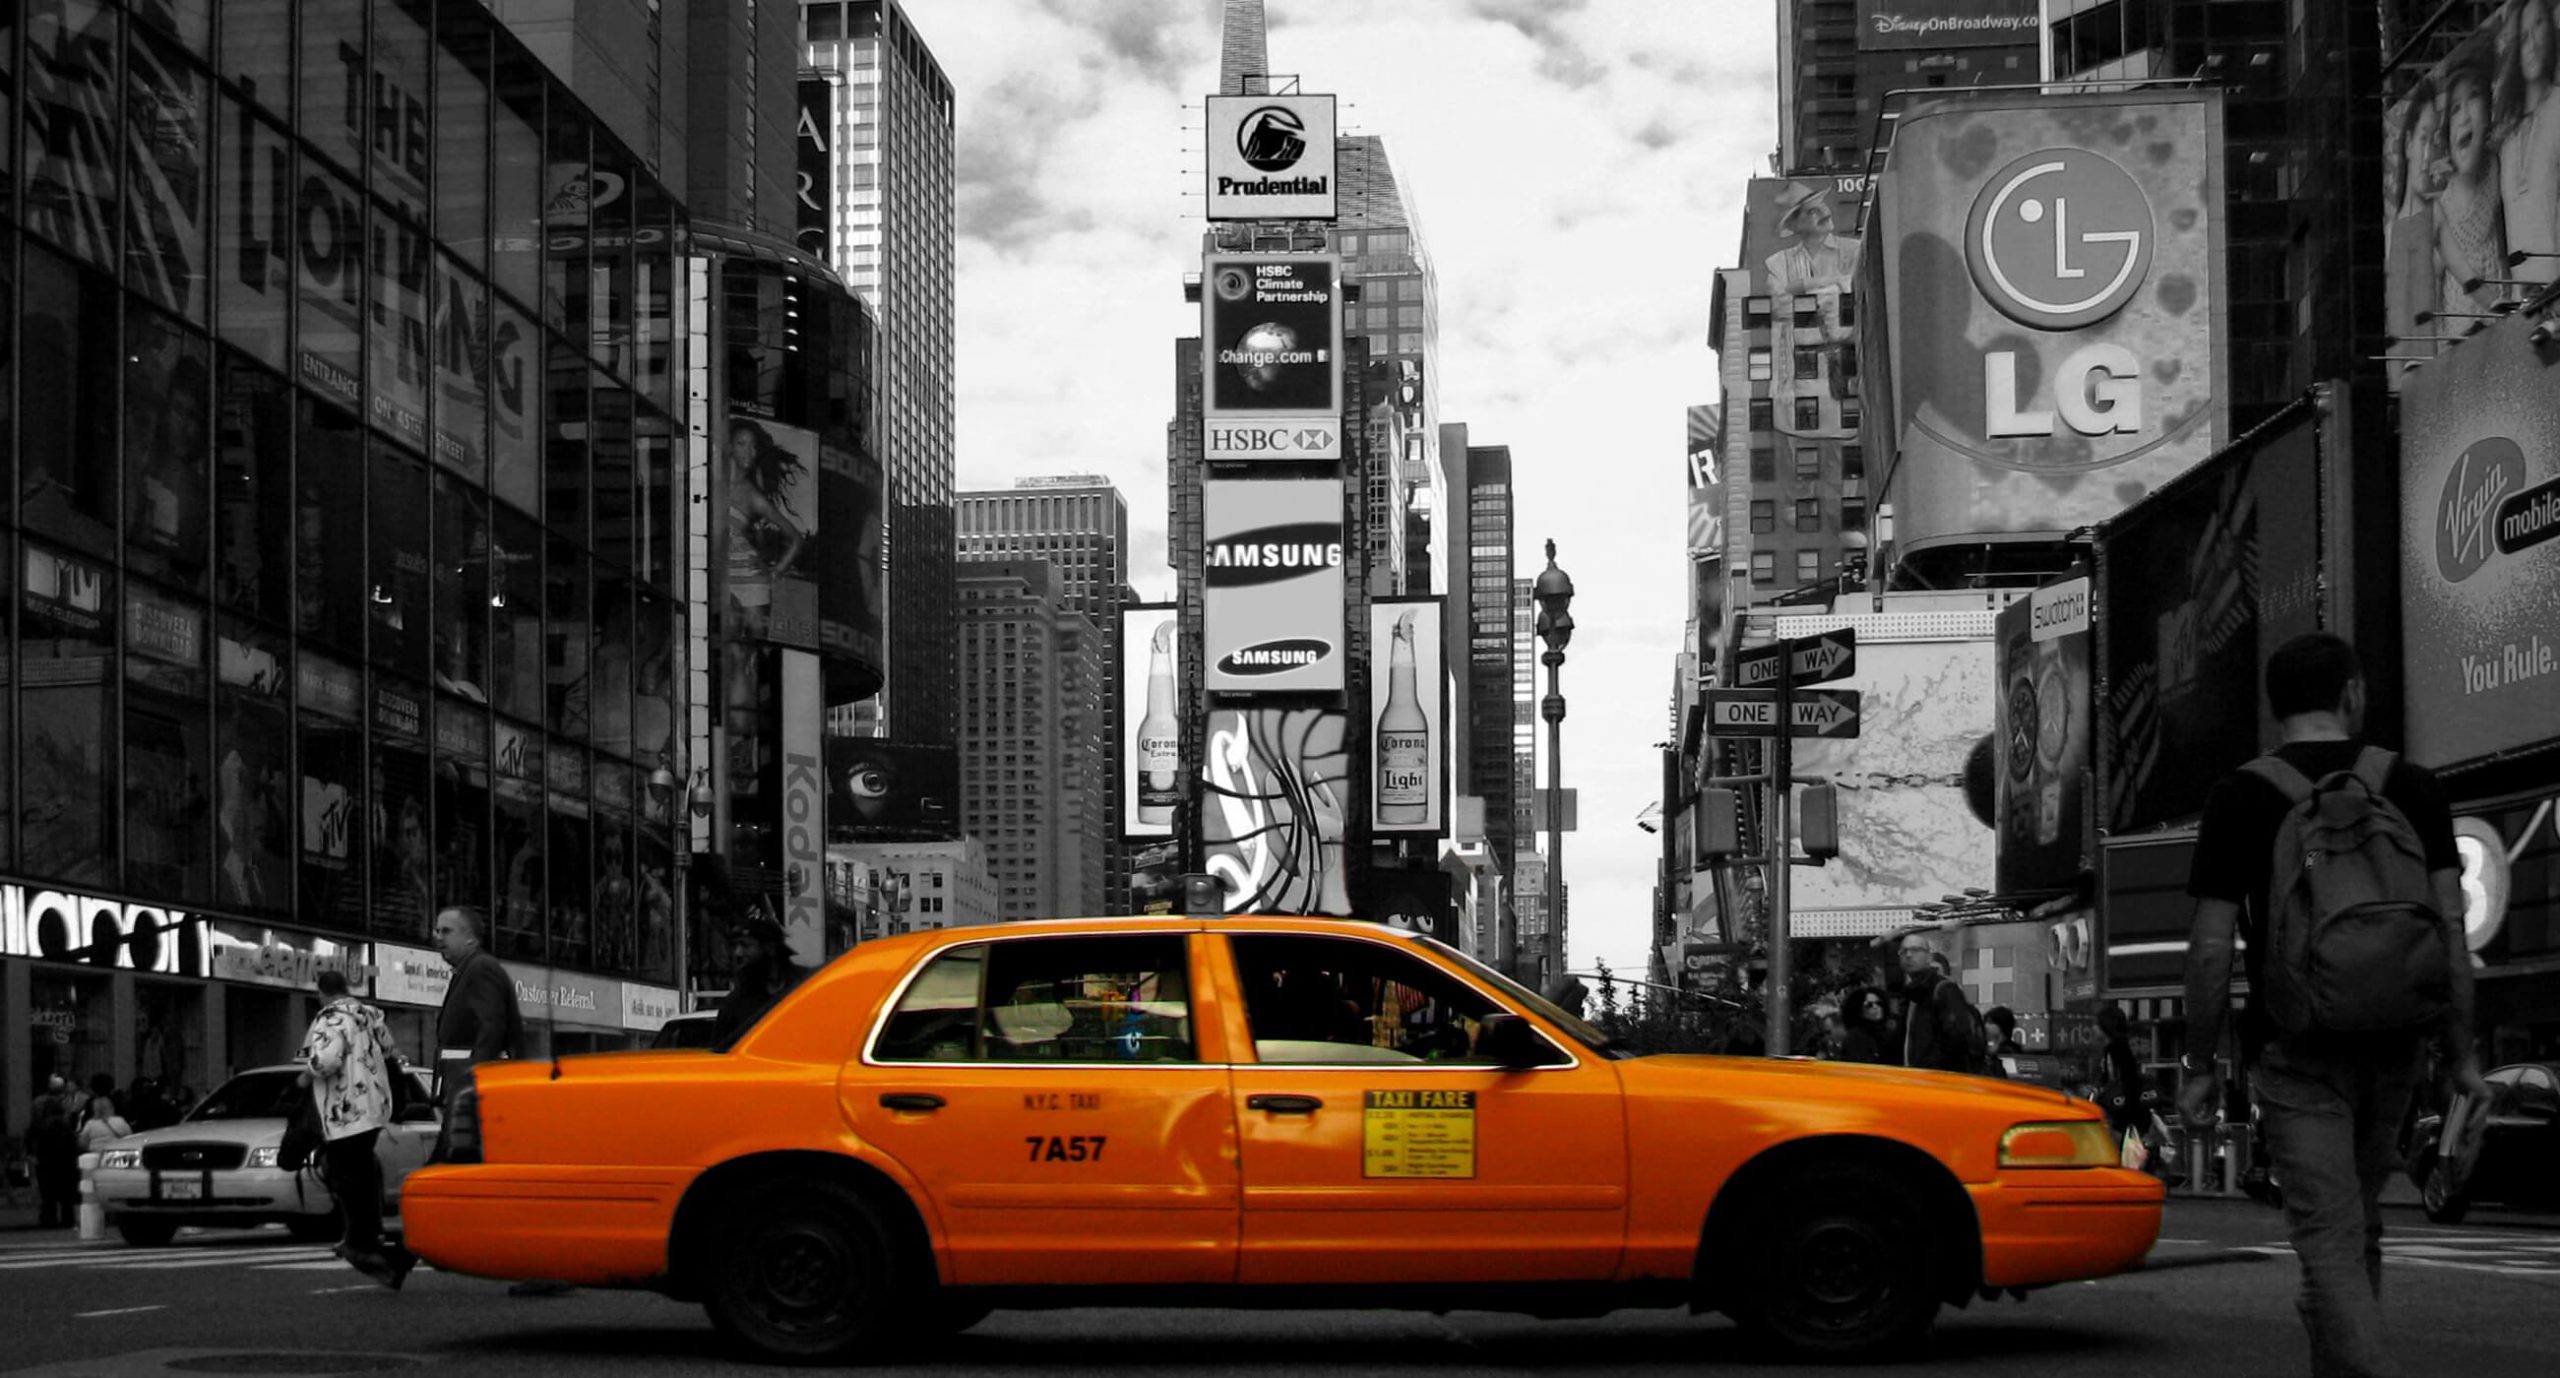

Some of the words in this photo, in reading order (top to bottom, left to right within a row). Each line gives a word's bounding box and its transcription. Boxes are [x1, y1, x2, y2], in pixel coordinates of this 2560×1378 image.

[339, 38, 427, 182] THE
[1217, 176, 1327, 195] Prudential
[239, 75, 386, 328] LION
[1256, 265, 1292, 277] HSBC
[1256, 278, 1303, 290] Climate
[1256, 291, 1328, 304] Partnership
[1218, 349, 1312, 367] Change.com
[302, 352, 361, 401] ENTRANCE
[374, 395, 393, 420] ON
[1984, 343, 2141, 441] LG
[1210, 429, 1289, 451] HSBC
[2444, 453, 2509, 563] Virgin
[2503, 491, 2560, 541] mobile
[1232, 650, 1318, 665] SAMSUNG
[1750, 658, 1779, 680] ONE
[1804, 646, 1840, 669] WAY
[2461, 654, 2499, 695] You
[2503, 635, 2558, 684] Rule.
[1728, 704, 1769, 722] ONE
[1798, 704, 1841, 723] WAY
[786, 752, 818, 927] Kodak
[1069, 1093, 1100, 1111] TAXI
[1372, 1091, 1413, 1107] TAXI
[1420, 1091, 1469, 1107] FARE
[1025, 1136, 1107, 1162] 7A57
